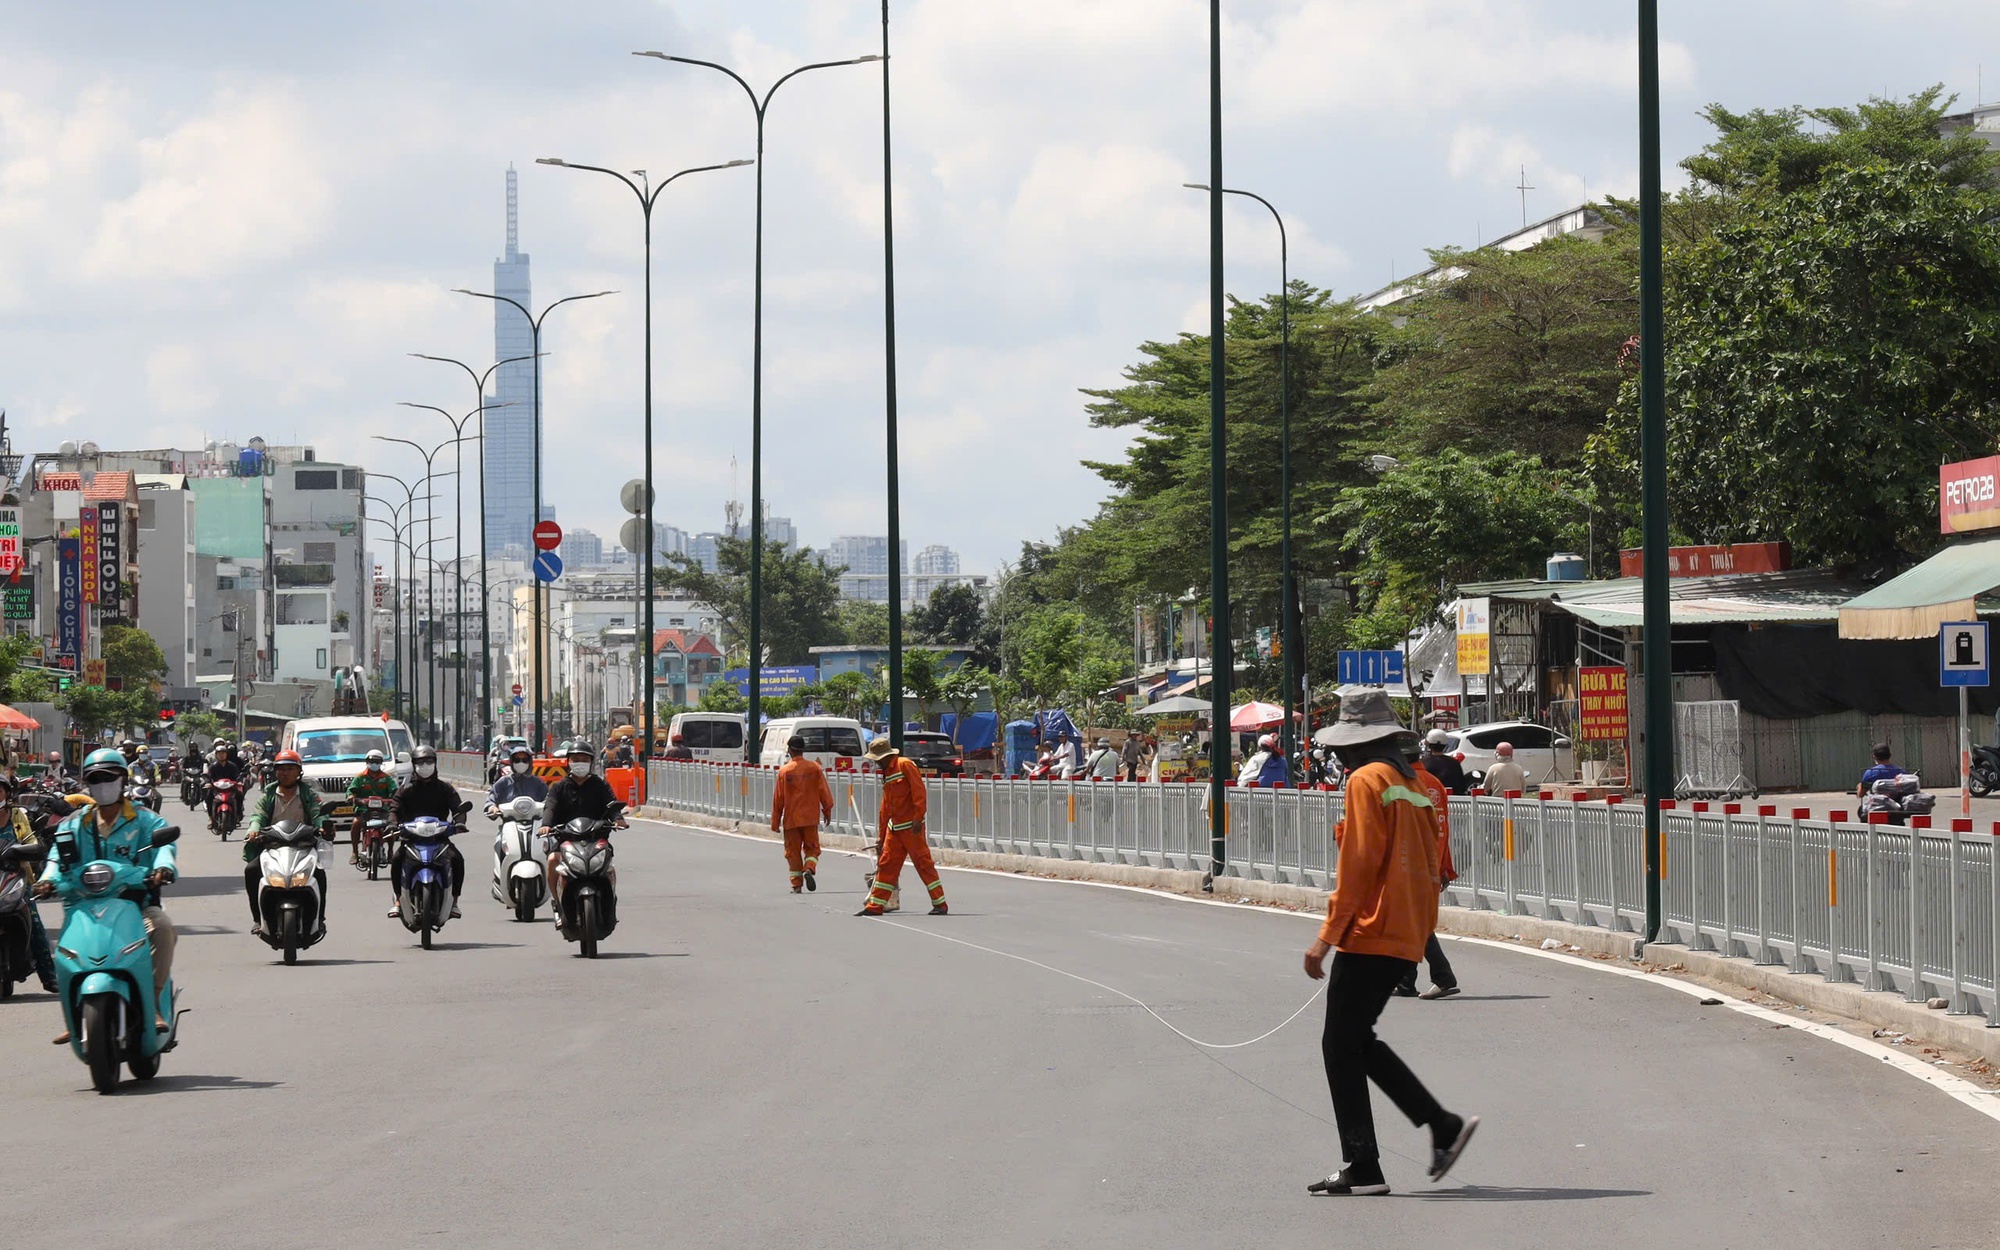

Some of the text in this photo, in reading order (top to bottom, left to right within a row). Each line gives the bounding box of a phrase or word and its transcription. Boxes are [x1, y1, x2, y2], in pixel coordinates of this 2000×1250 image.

[44, 479, 80, 490] KHOA
[102, 509, 116, 592] COFFEE
[84, 526, 96, 600] NHA KHOA
[1710, 551, 1734, 571] THUẬT
[64, 564, 75, 611] LONG
[1580, 670, 1626, 691] RỬA XE
[1582, 692, 1626, 710] THAY NHỚT
[1600, 728, 1610, 738] XE
